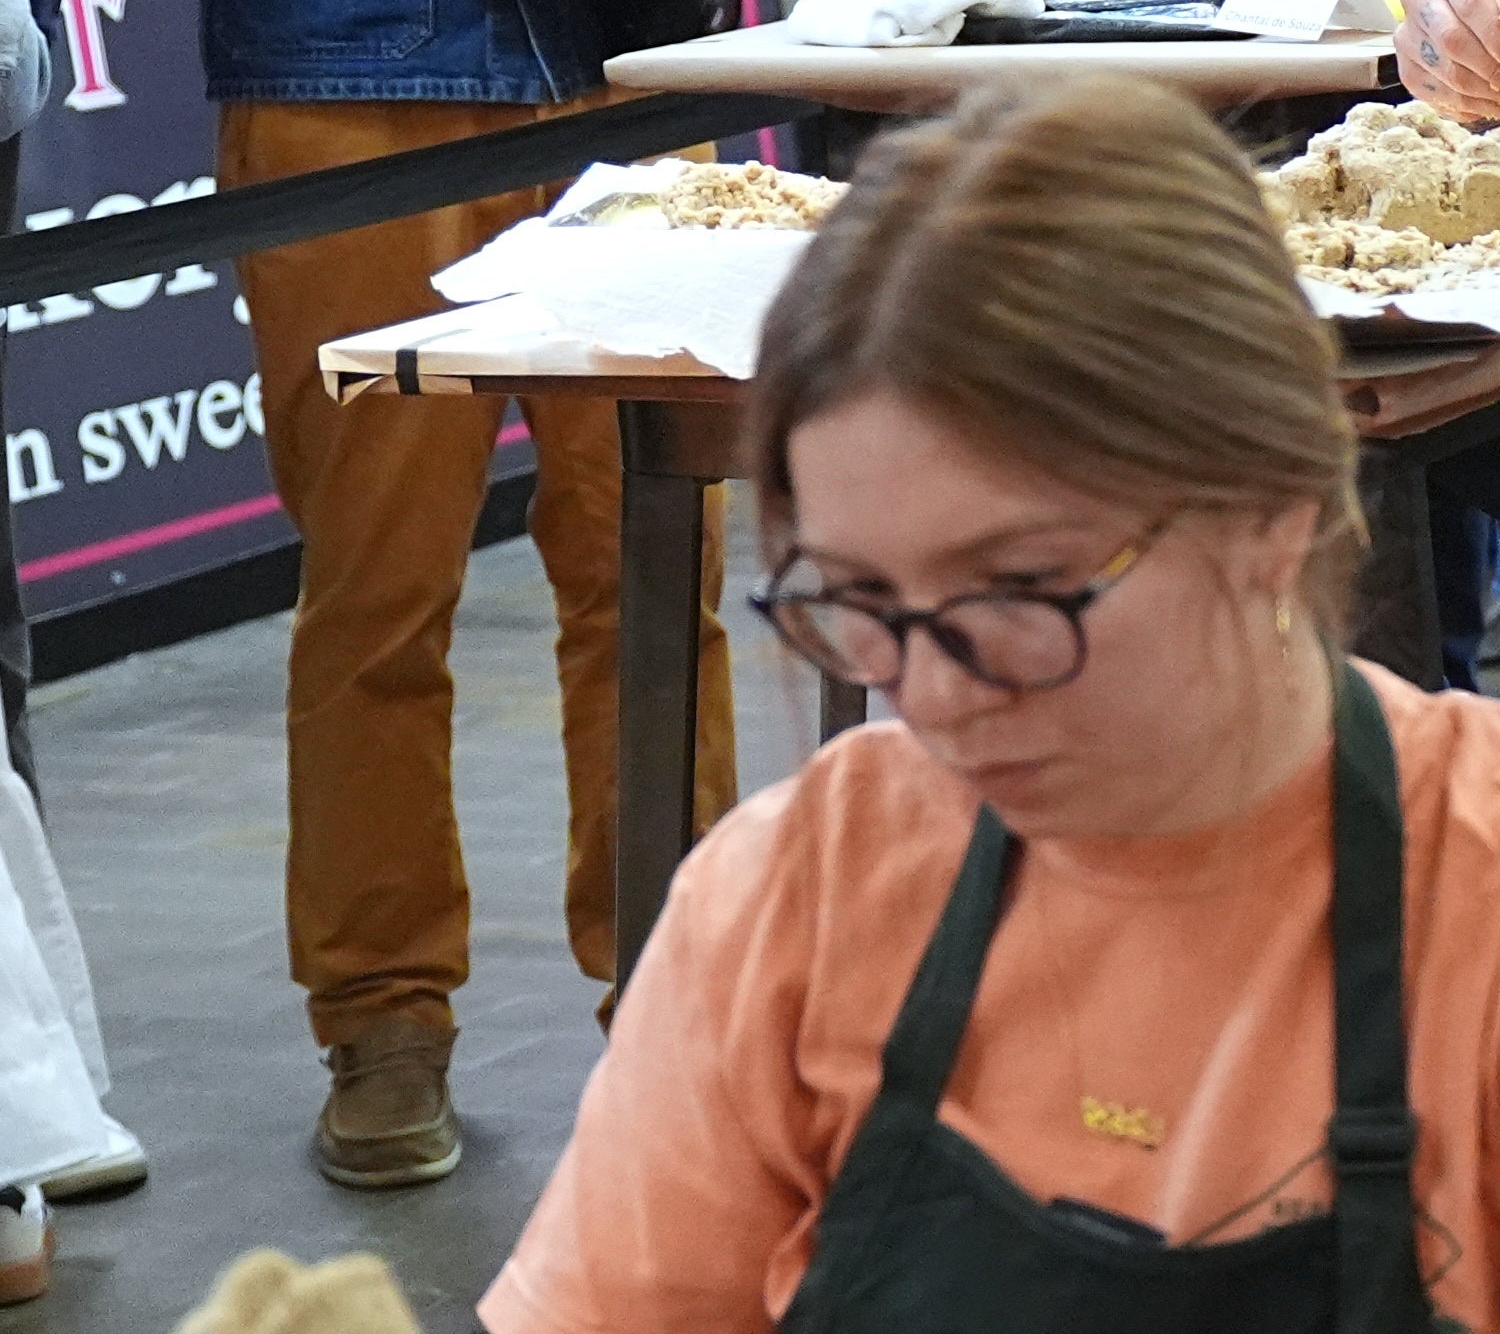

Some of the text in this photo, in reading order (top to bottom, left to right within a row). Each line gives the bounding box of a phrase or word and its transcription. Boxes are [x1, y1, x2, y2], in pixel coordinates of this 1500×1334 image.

[1225, 10, 1323, 33] Chantal de Souza
